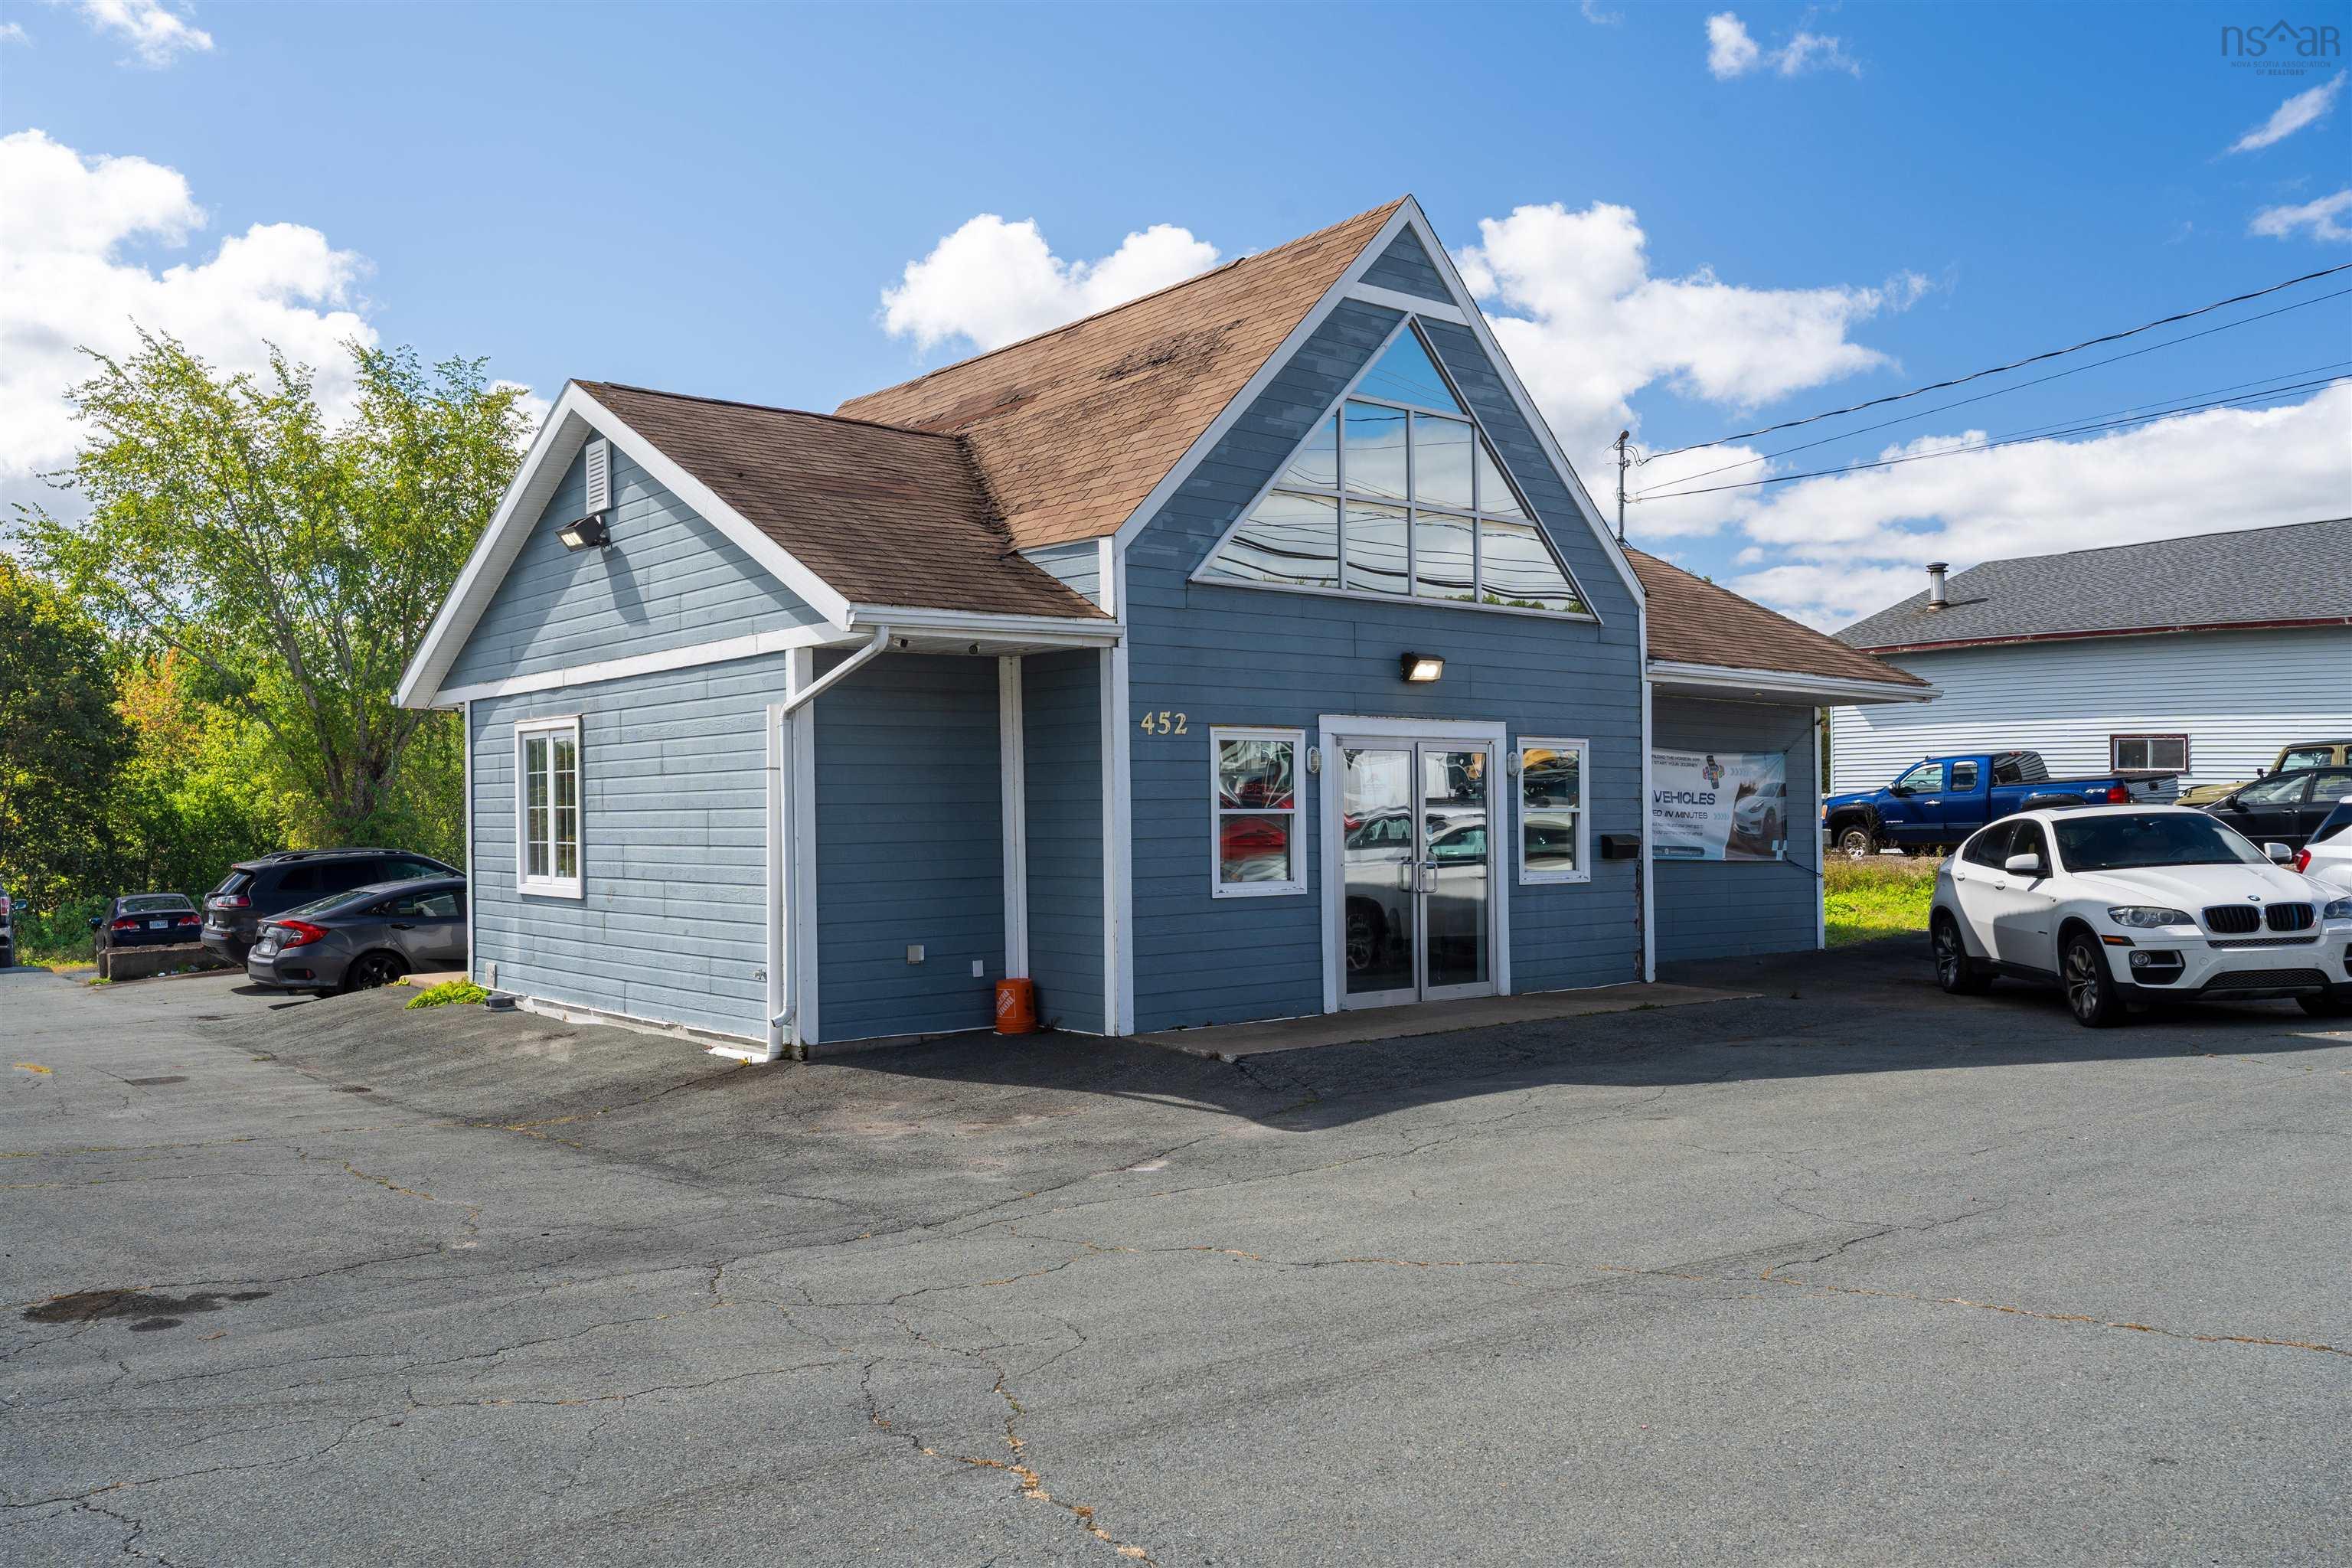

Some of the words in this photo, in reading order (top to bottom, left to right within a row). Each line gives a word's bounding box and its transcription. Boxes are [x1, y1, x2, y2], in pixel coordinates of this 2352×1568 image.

[1140, 710, 1188, 735] 452
[1653, 789, 1716, 805] VEHICLES
[1674, 810, 1708, 819] MINUTES
